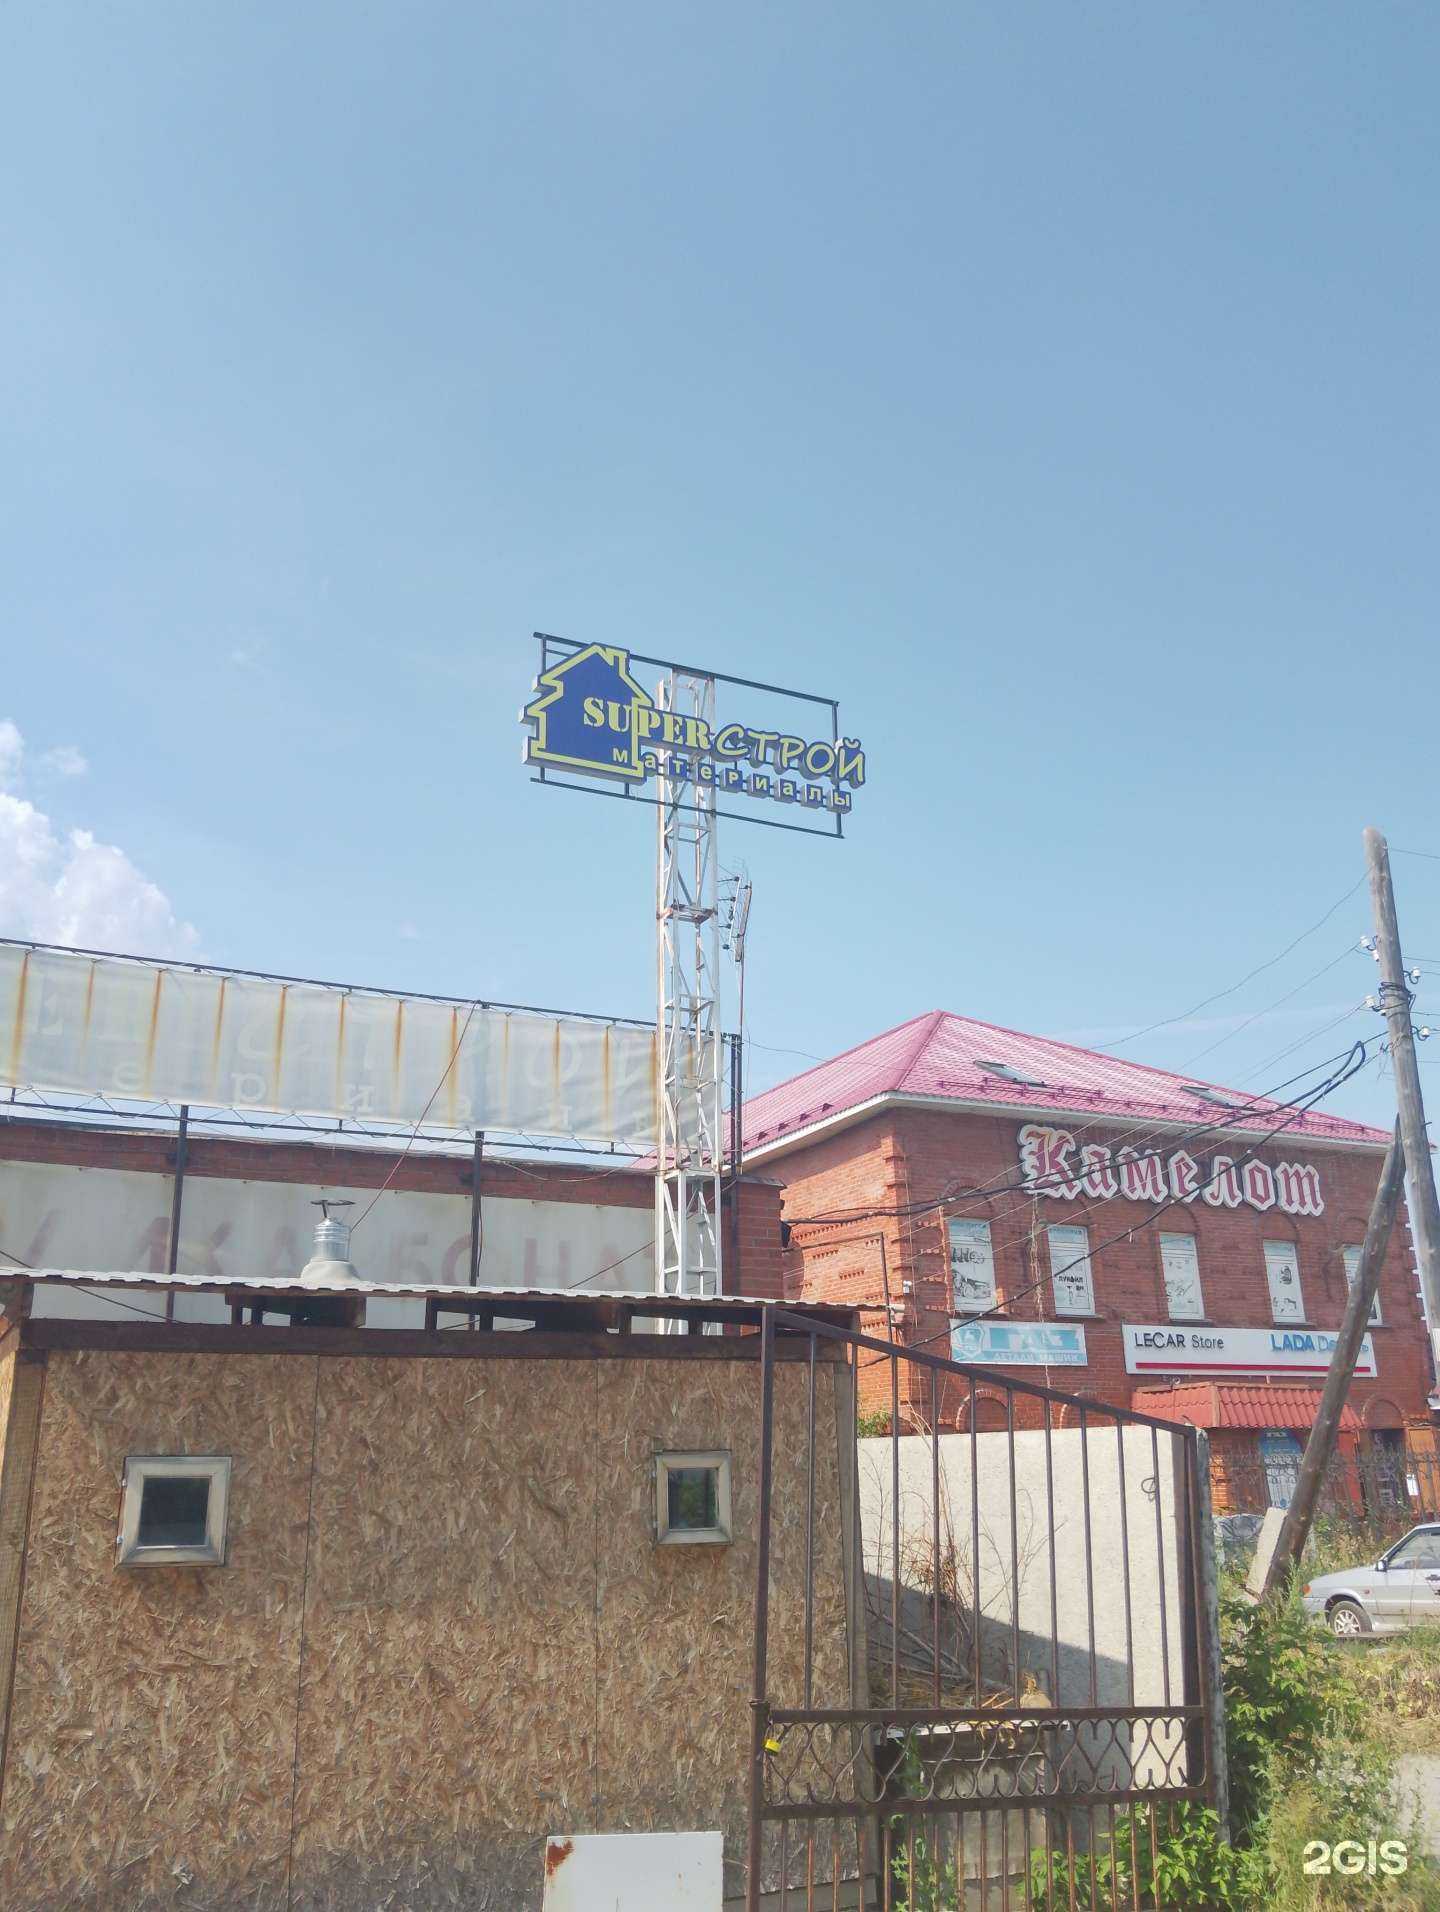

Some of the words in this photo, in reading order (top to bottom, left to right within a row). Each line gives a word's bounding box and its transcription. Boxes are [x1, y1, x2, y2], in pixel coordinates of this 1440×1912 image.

[1021, 1126, 1324, 1215] Камелот
[1134, 1332, 1186, 1348] LECAR
[1191, 1334, 1224, 1349] Store
[1271, 1334, 1315, 1351] LADA
